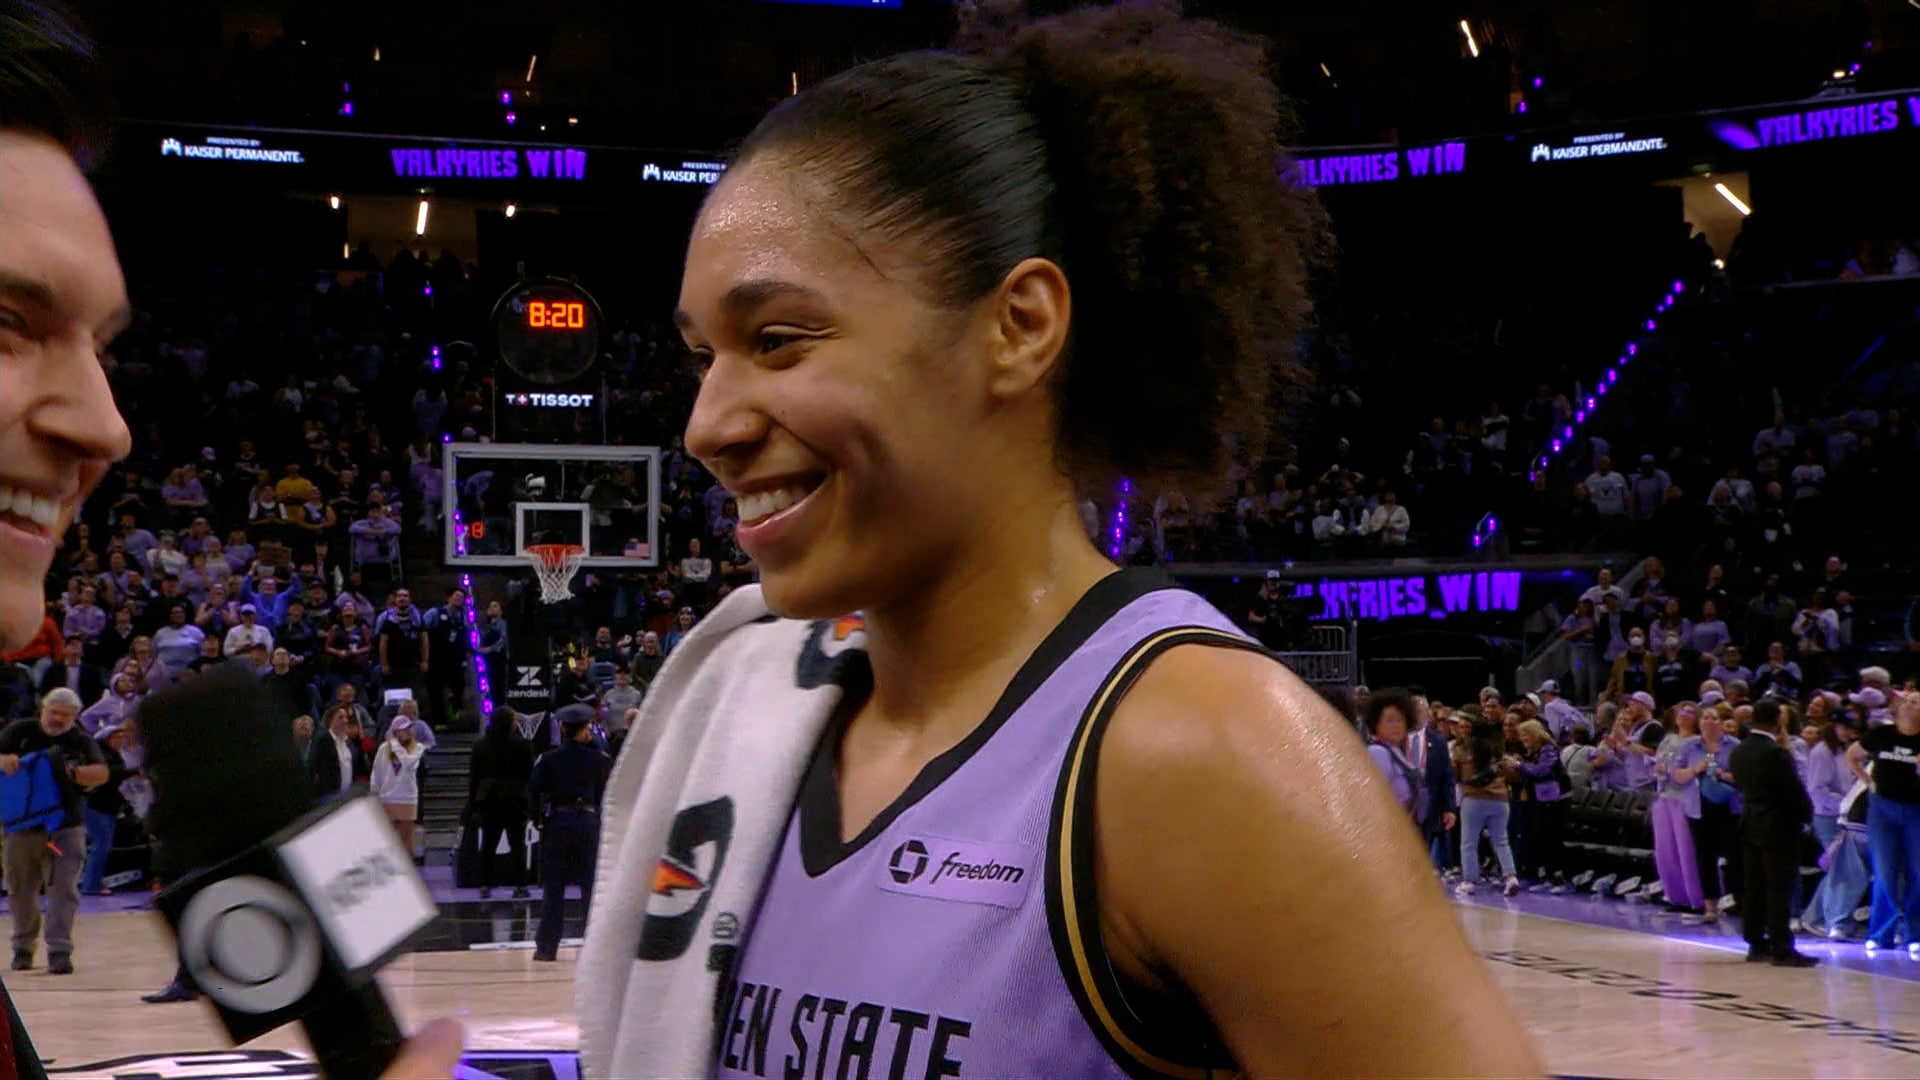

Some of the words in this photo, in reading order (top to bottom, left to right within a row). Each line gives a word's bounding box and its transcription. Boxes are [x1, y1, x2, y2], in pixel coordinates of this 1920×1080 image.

[1757, 100, 1898, 147] VALKYRIES
[184, 145, 222, 159] KAISER
[225, 147, 300, 163] PERMANENTE
[1407, 143, 1465, 177] WIN
[1553, 145, 1588, 160] KAISER
[1591, 137, 1664, 156] PERMANENTE
[391, 149, 518, 177] VALKYRIES
[526, 148, 586, 180] WIN
[663, 170, 697, 182] KAISER
[529, 302, 583, 328] 8:20
[529, 393, 593, 407] TISSOT
[1439, 571, 1521, 612] WIN
[508, 688, 549, 698] zendesk
[930, 851, 1024, 884] freedom
[784, 993, 972, 1080] STATE
